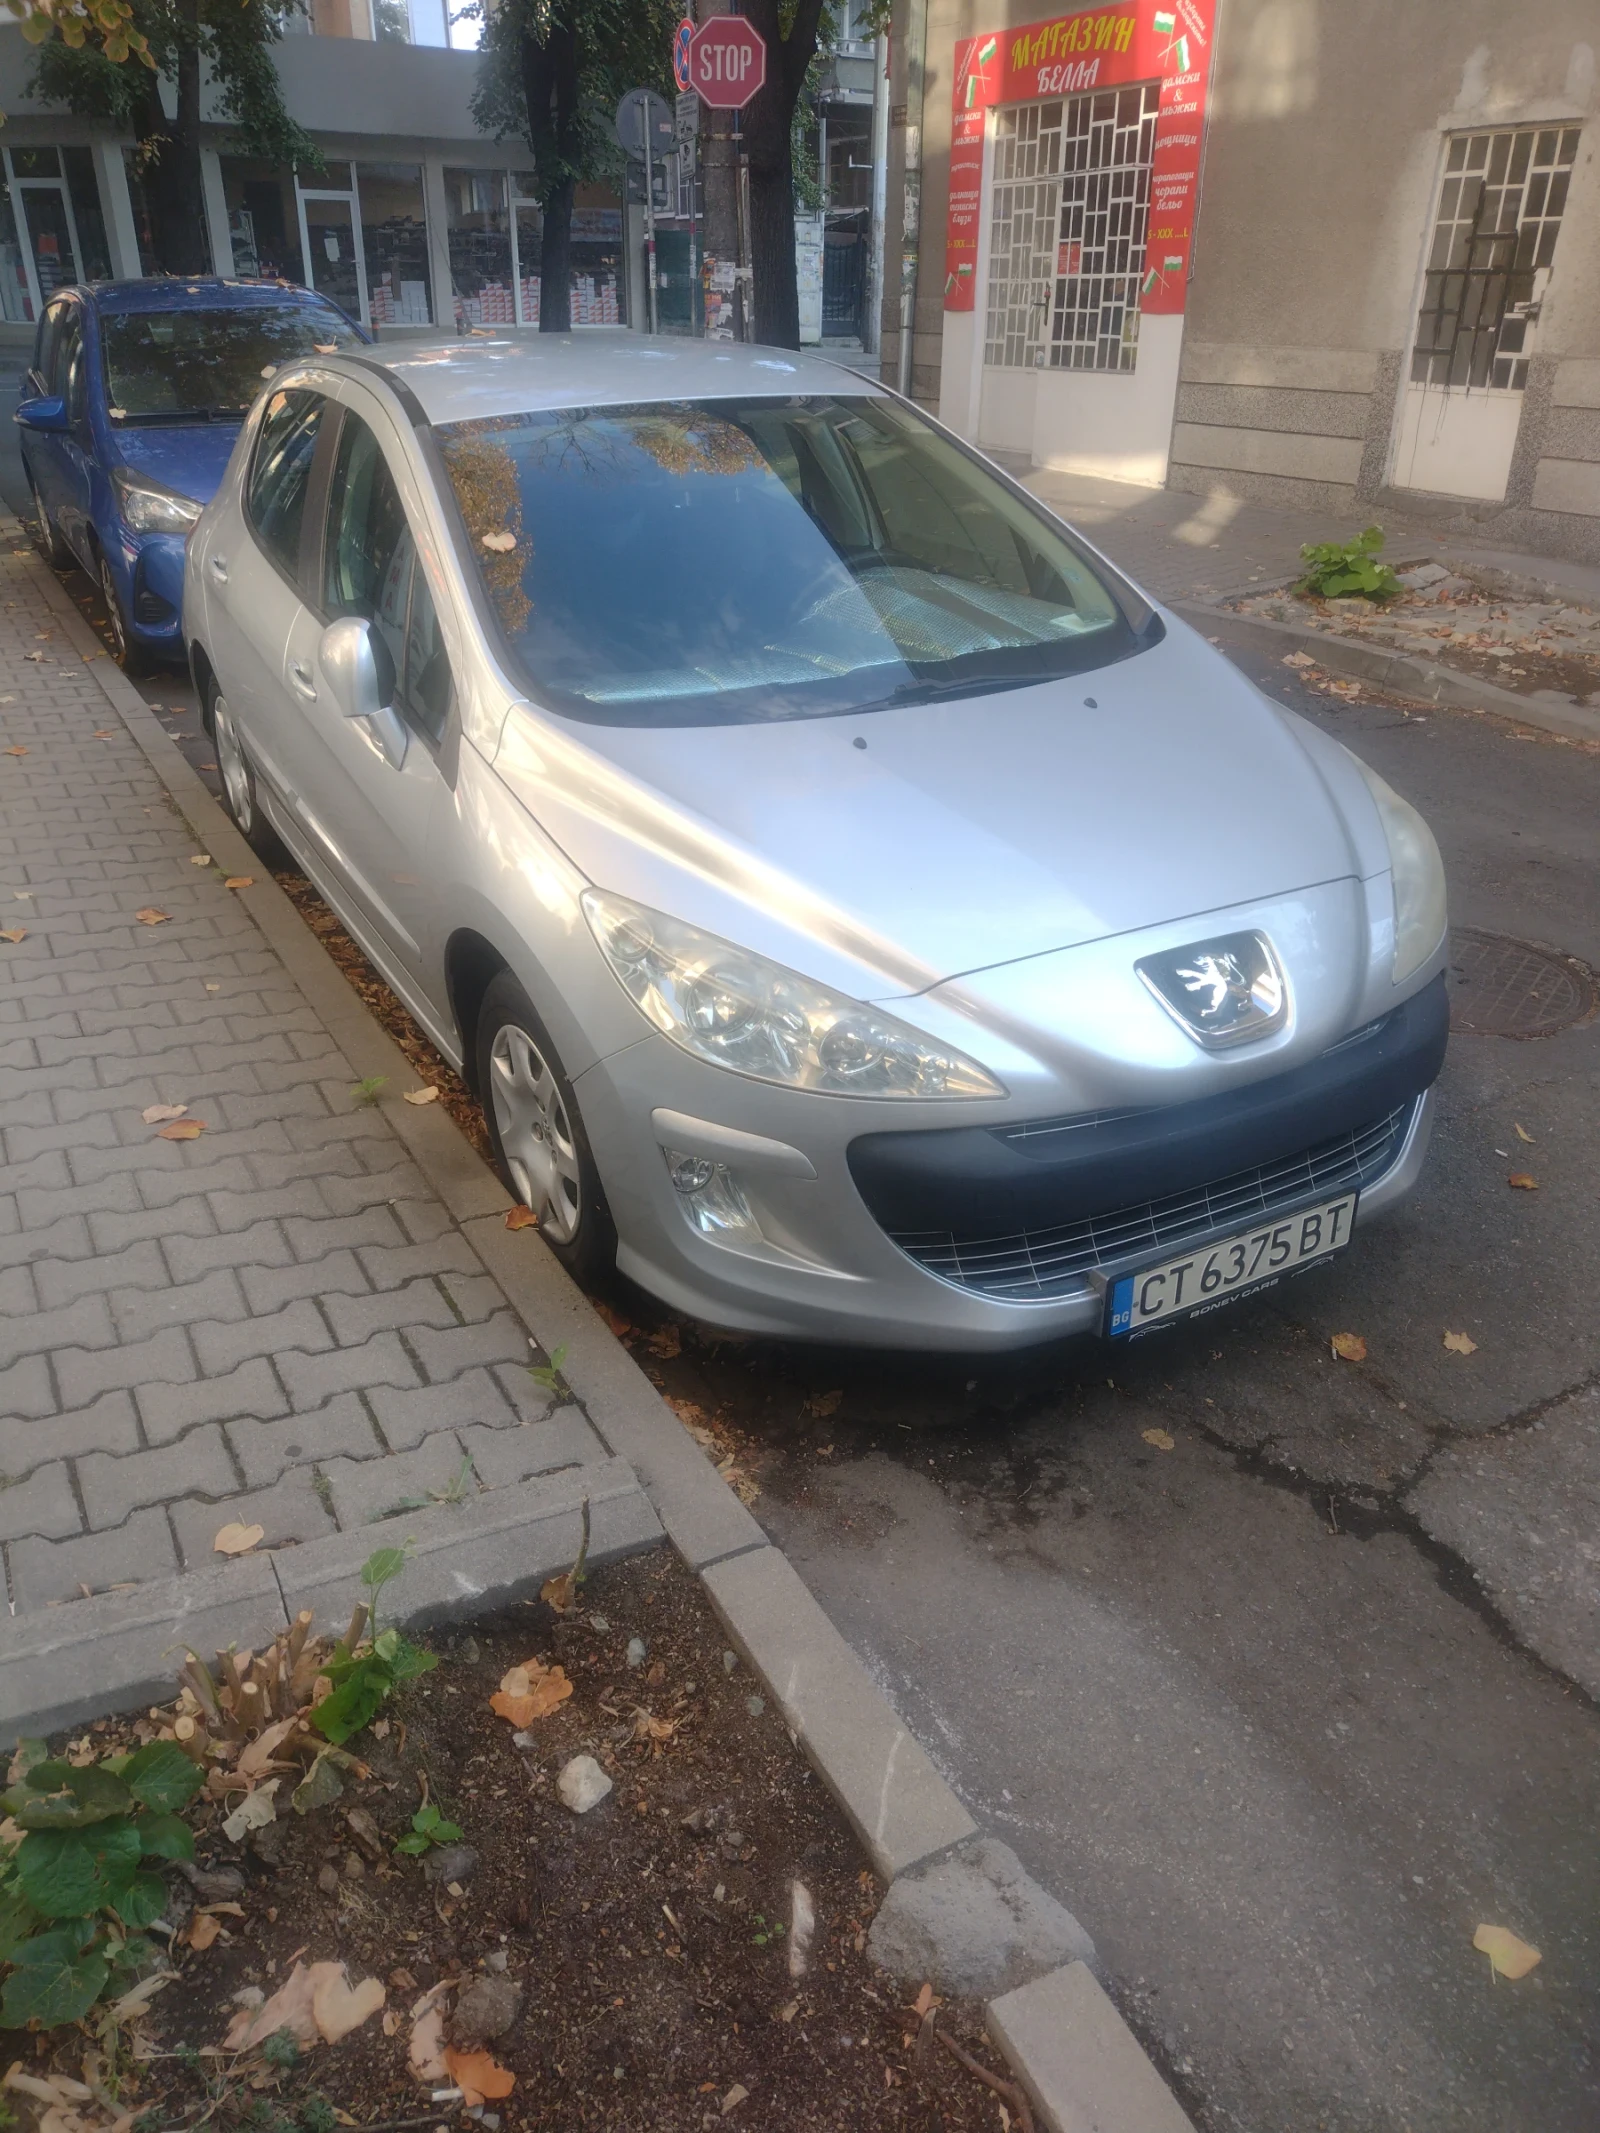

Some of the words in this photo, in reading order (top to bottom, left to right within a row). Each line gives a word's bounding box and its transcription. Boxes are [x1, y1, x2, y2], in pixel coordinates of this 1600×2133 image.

[1011, 15, 1136, 72] МАГАЗИН
[700, 43, 752, 81] STOP
[1037, 57, 1100, 93] БЕЛЛА
[1162, 72, 1201, 92] дамски
[1173, 88, 1183, 102] &
[954, 111, 982, 126] дамски
[1160, 102, 1197, 117] мъжки
[963, 123, 971, 135] &
[1155, 185, 1188, 200] чорапи
[1156, 197, 1183, 210] бельо
[1139, 1261, 1194, 1316] CT
[1200, 1223, 1293, 1293] 6375
[1298, 1202, 1349, 1257] BT
[1190, 1294, 1240, 1319] BONEV
[1241, 1278, 1280, 1299] CARS
[1112, 1308, 1130, 1328] BG
